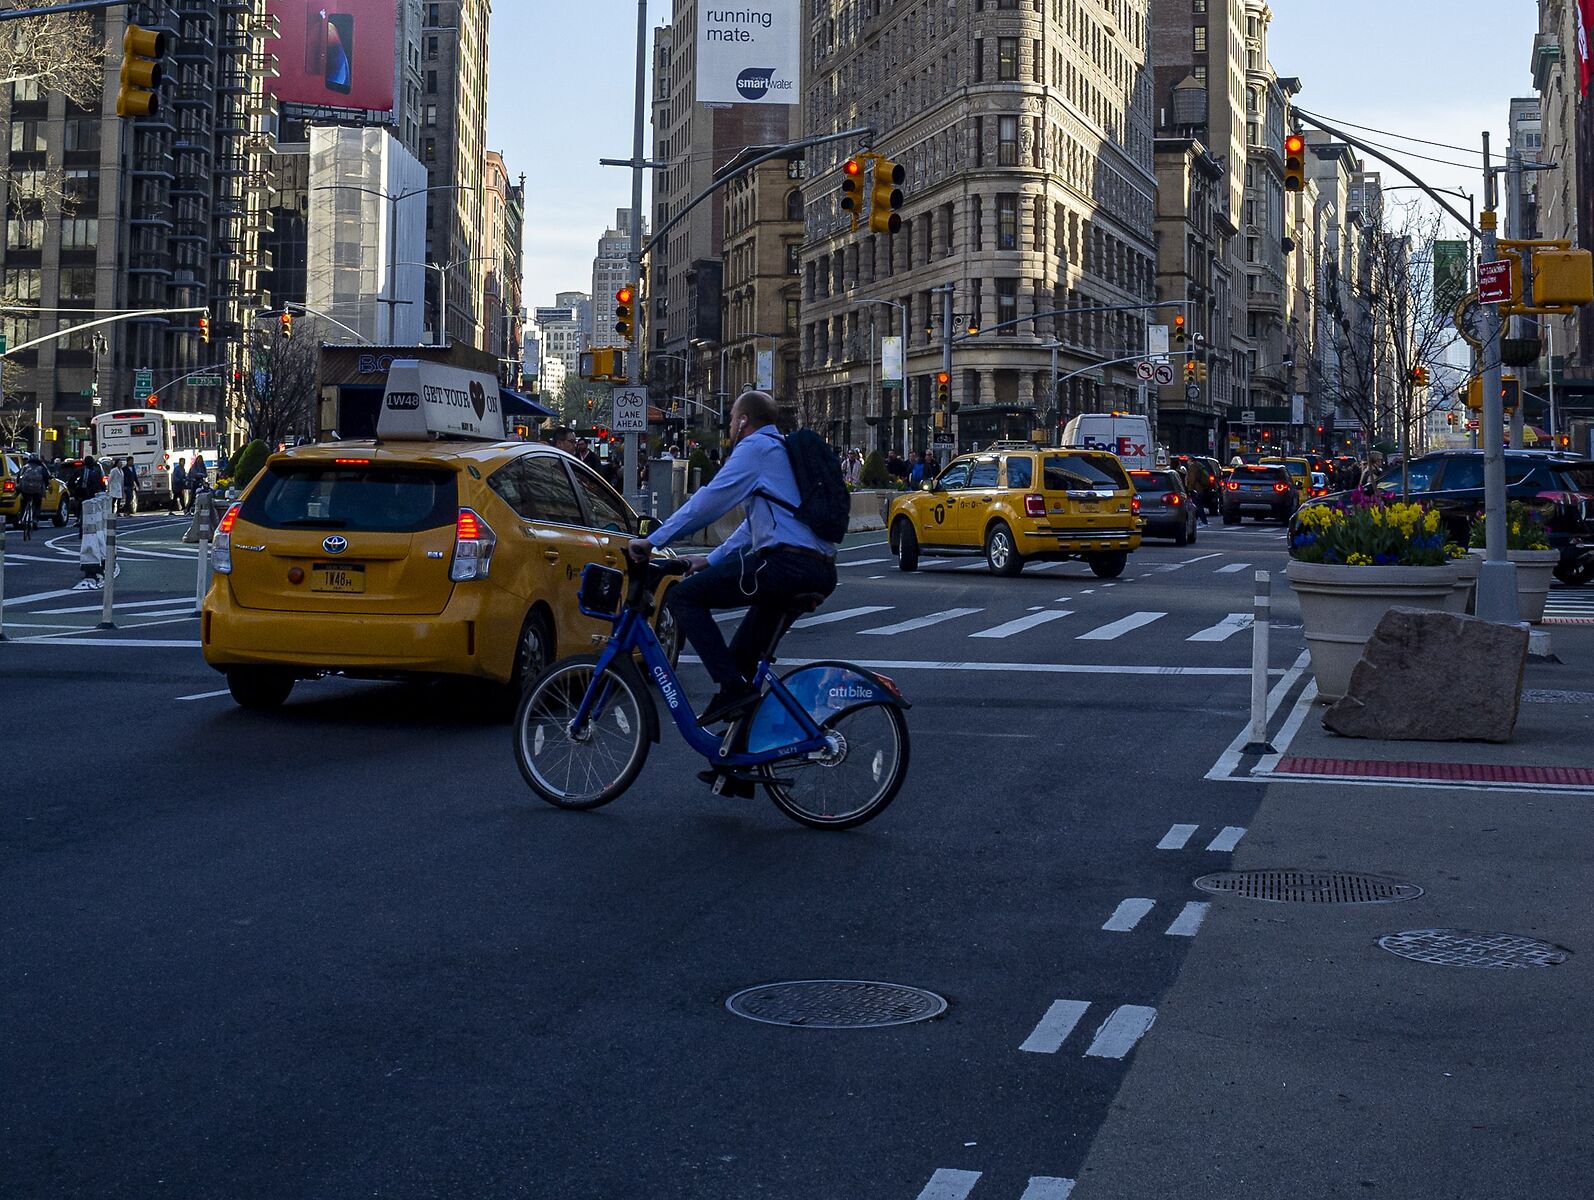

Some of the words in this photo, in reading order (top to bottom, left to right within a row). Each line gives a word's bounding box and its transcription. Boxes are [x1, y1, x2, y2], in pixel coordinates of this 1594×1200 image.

[707, 8, 772, 28] running
[707, 27, 755, 42] mate.
[359, 354, 414, 374] BO
[387, 395, 419, 406] 1W48
[423, 384, 443, 404] GET
[442, 387, 471, 409] YOUR
[486, 395, 498, 413] ON
[619, 410, 641, 419] LANE
[616, 420, 643, 428] AHEAD
